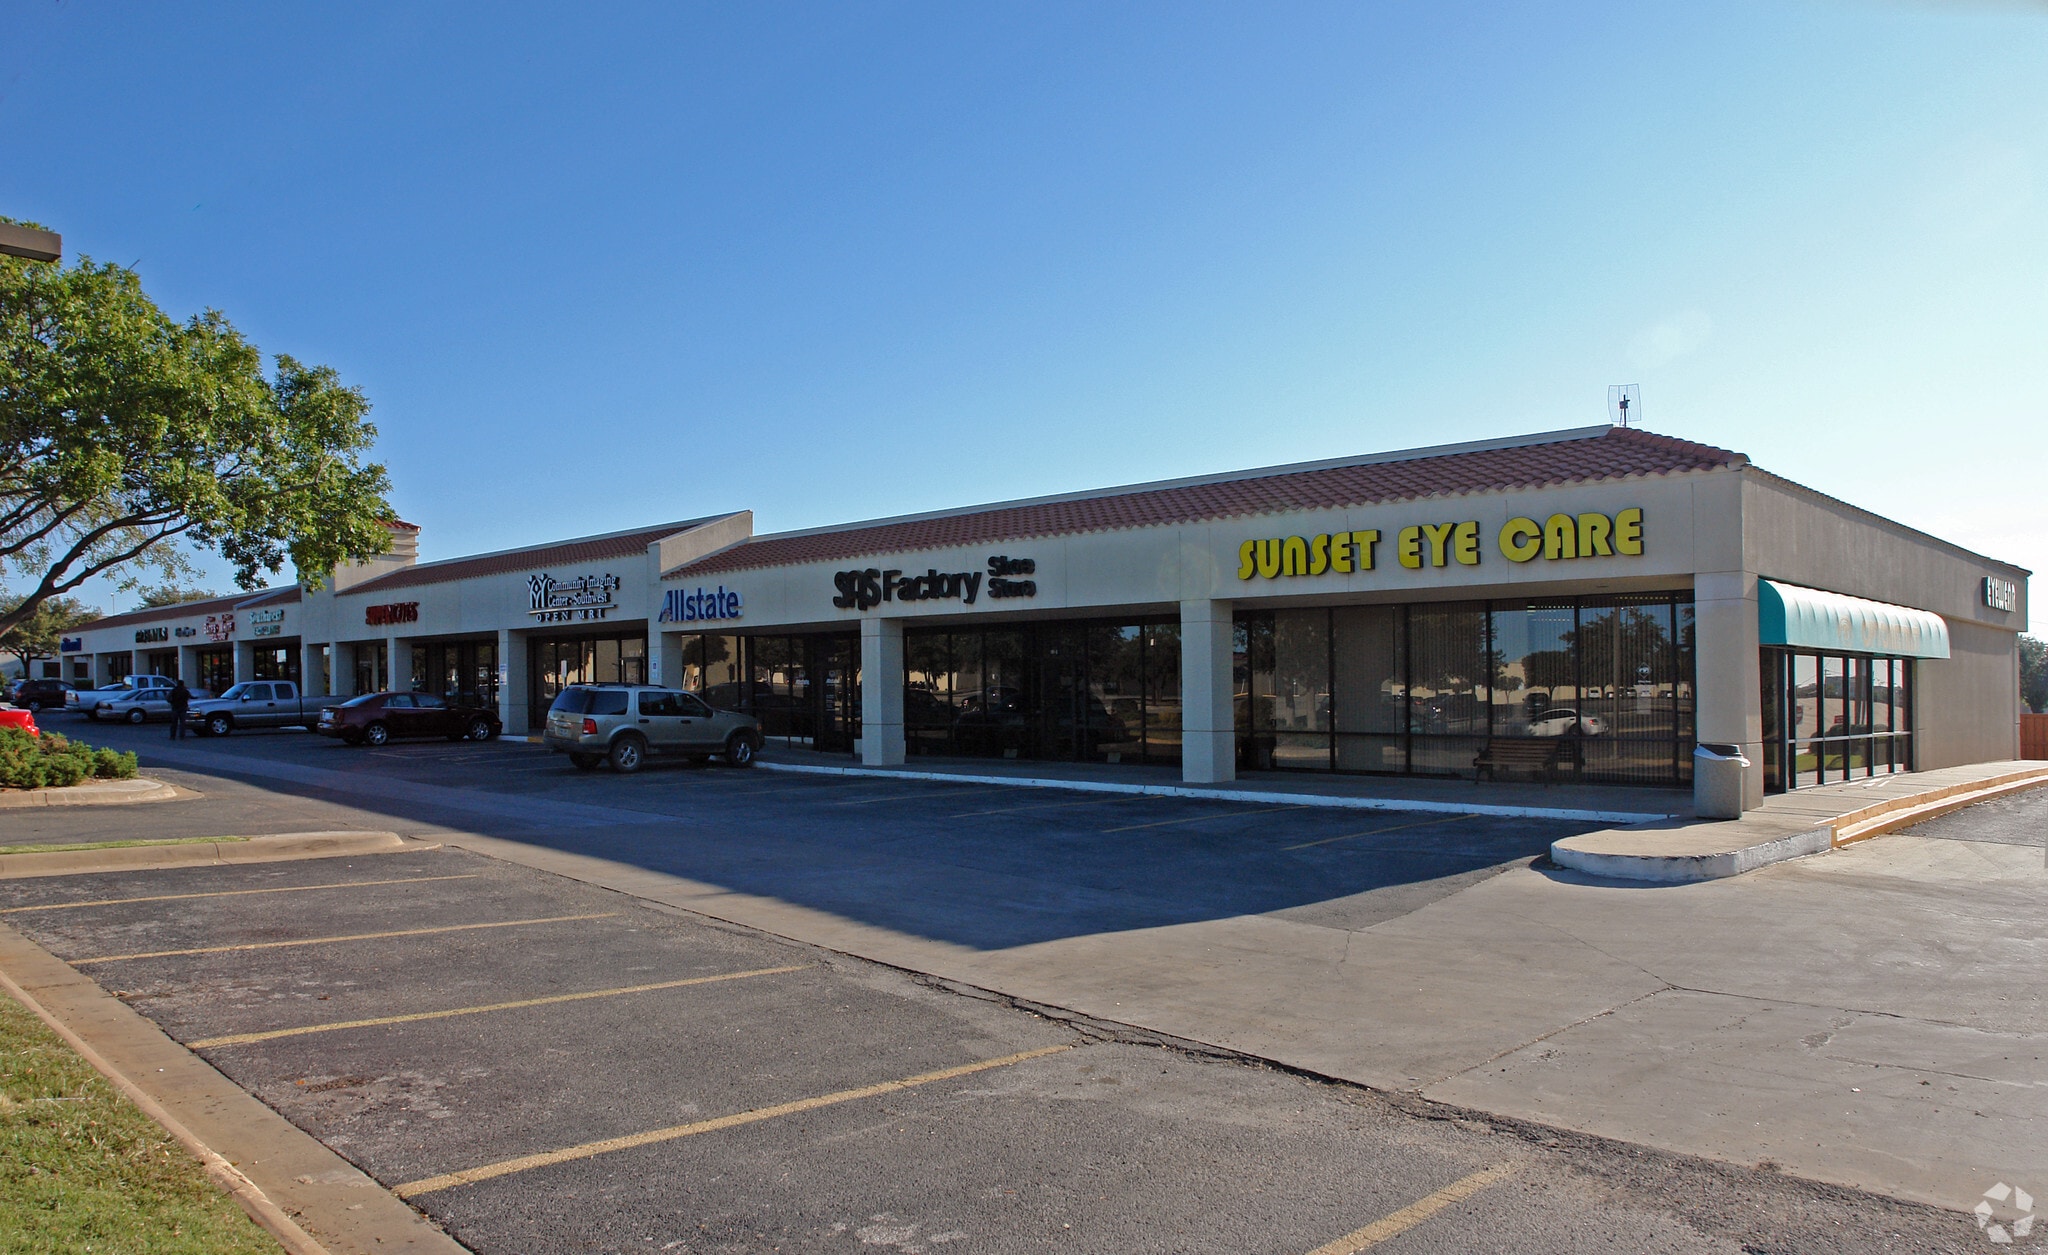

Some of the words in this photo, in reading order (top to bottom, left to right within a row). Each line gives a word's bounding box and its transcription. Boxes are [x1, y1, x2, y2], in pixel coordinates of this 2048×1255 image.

[1238, 529, 1381, 580] SUNSET
[1398, 520, 1481, 569] EYE
[1498, 507, 1645, 563] CARE
[988, 555, 1035, 576] Shoe
[547, 578, 586, 592] Community
[587, 574, 618, 591] Imaging
[883, 569, 982, 604] Factory
[1985, 576, 2016, 612] EYEWEAR
[547, 594, 569, 607] Center
[574, 591, 608, 605] Southwest
[658, 586, 743, 622] Allstate
[536, 610, 570, 622] OPEN
[578, 608, 603, 619] MRI
